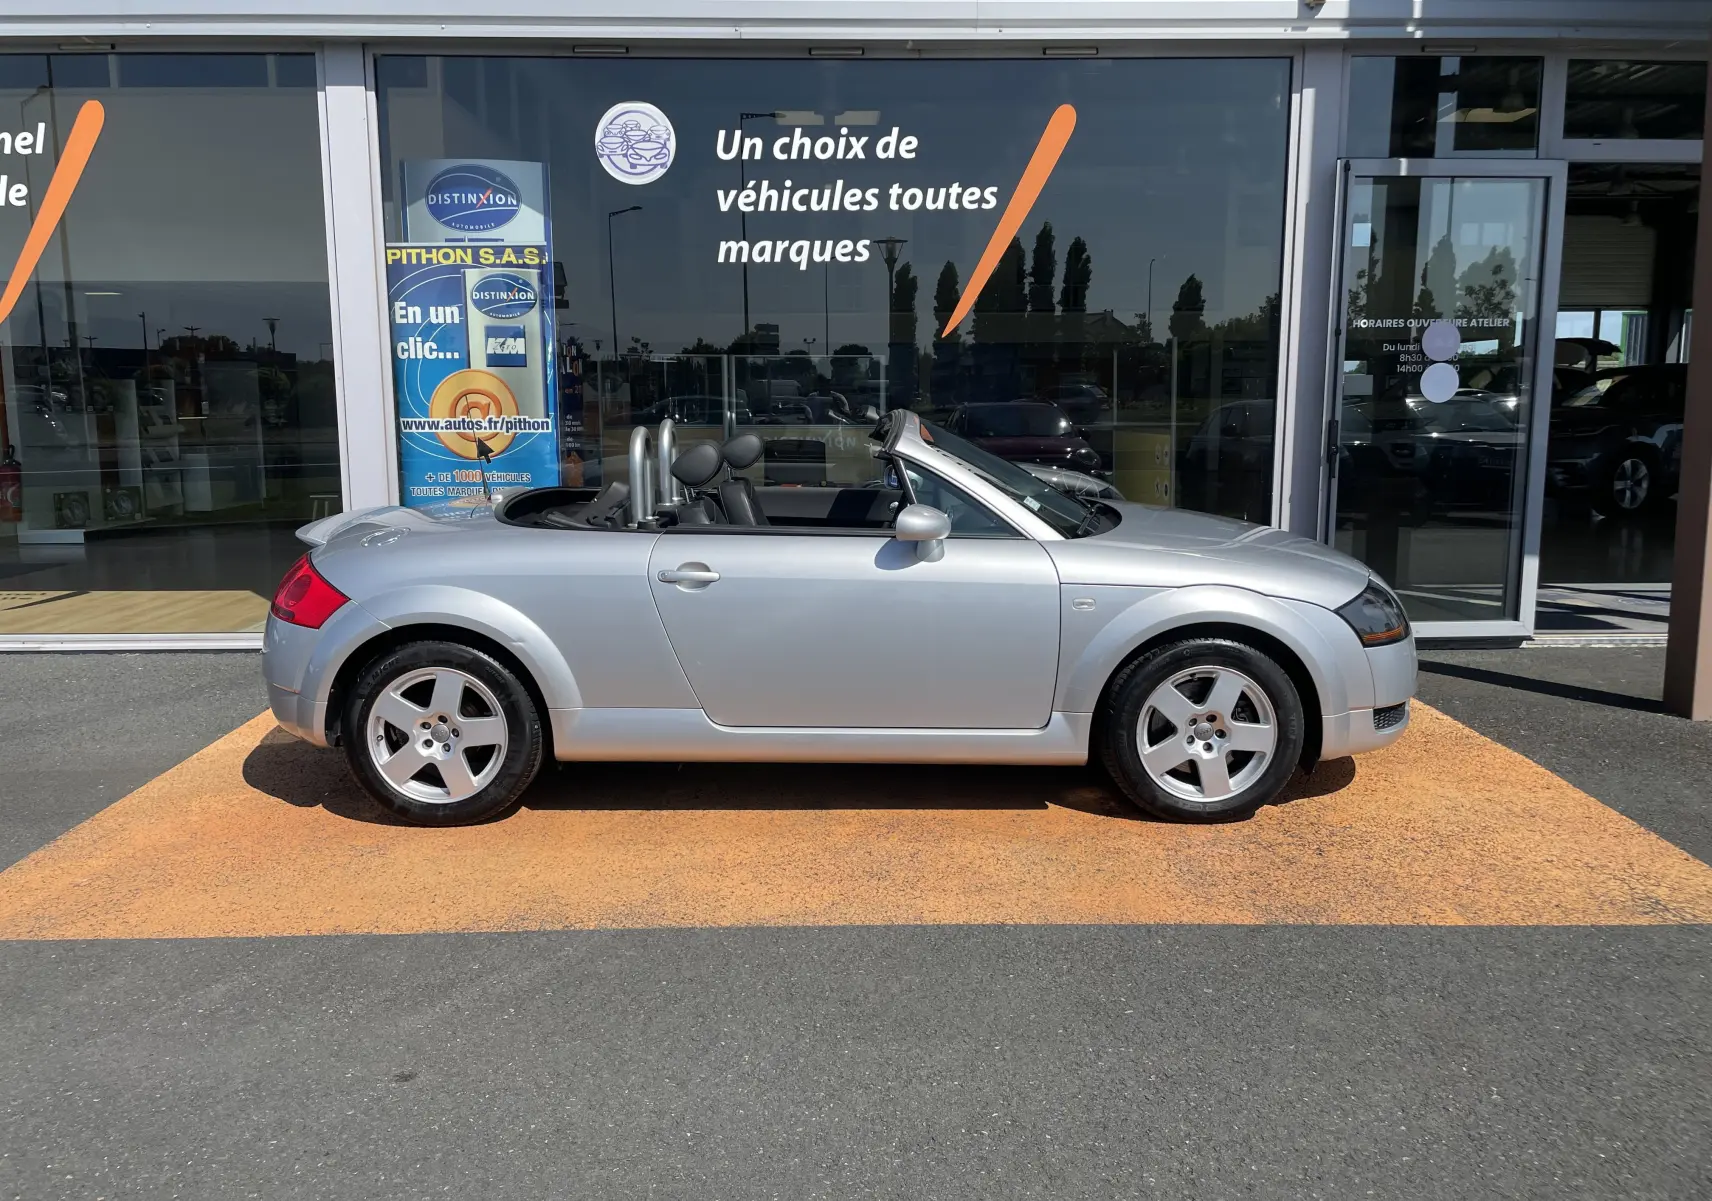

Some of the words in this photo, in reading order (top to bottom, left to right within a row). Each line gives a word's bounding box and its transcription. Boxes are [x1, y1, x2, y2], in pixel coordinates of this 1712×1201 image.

[716, 129, 763, 160] Un
[773, 127, 869, 160] choix
[876, 126, 919, 159] de
[428, 191, 517, 207] DISTINXION
[717, 179, 880, 212] véhicules
[889, 182, 998, 210] toutes
[387, 249, 472, 265] PITHON
[479, 248, 548, 265] S.A.S.
[717, 239, 870, 271] marques
[472, 290, 535, 301] DISTINXION
[395, 302, 421, 323] En
[430, 306, 460, 323] un
[1353, 318, 1405, 328] HORAIRES
[1470, 318, 1510, 328] ATELIER
[397, 337, 460, 359] clic...
[486, 337, 526, 355] KM
[1383, 343, 1396, 351] Du
[1397, 343, 1421, 351] lundi
[1399, 353, 1423, 362] 8h30
[1396, 364, 1423, 373] 14h00
[402, 418, 550, 434] www.autos.fr/pithon
[438, 473, 450, 482] DE
[454, 470, 482, 482] 1000
[484, 471, 531, 482] VÉHICULES
[411, 486, 444, 496] TOUTES
[448, 486, 485, 496] MARQUE
